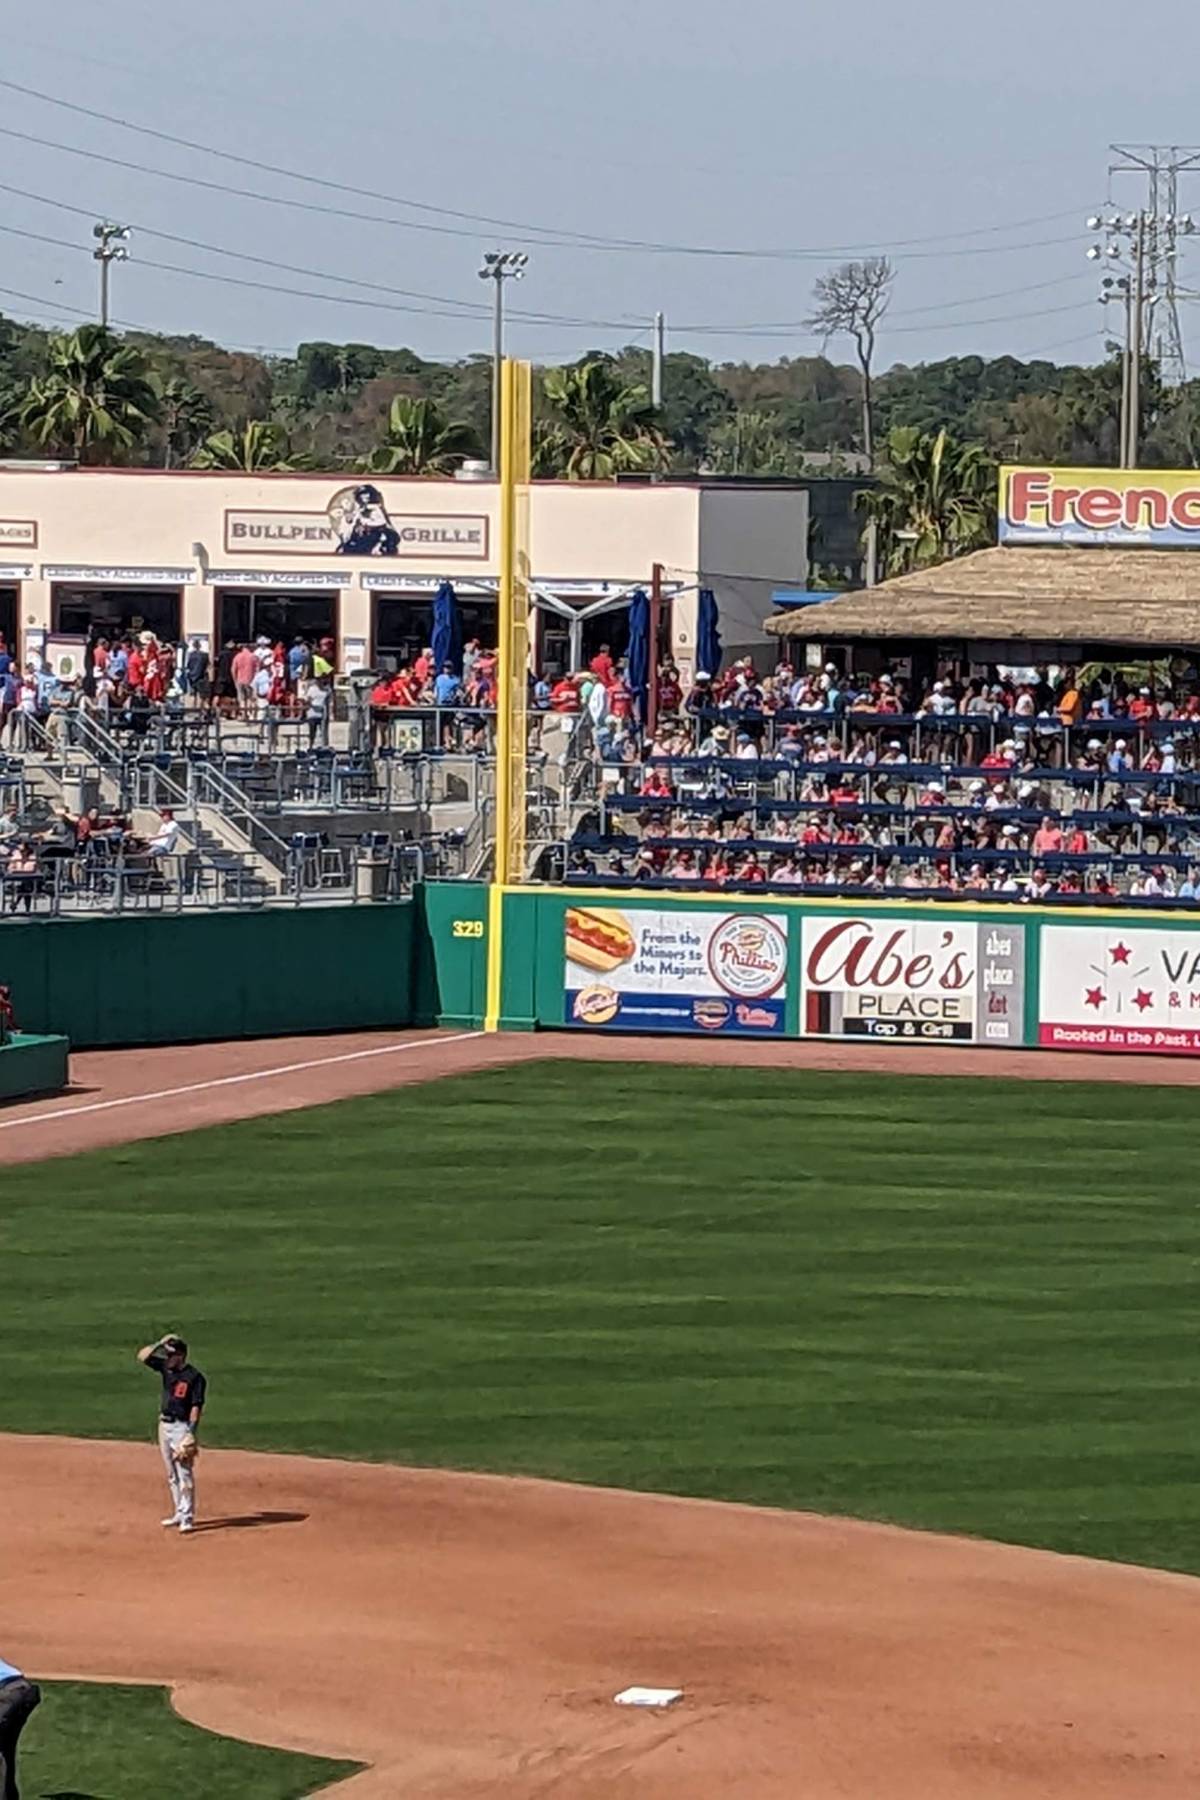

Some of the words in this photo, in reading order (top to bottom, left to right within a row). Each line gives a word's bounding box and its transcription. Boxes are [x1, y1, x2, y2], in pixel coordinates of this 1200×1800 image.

[453, 920, 483, 938] 329
[641, 929, 676, 945] From
[679, 930, 701, 946] the
[640, 946, 685, 961] Minors
[689, 948, 703, 961] to
[806, 920, 975, 990] Abe's
[633, 961, 655, 975] the
[858, 994, 961, 1018] PLACE
[1168, 990, 1182, 1009] &
[902, 1021, 916, 1036] &
[1053, 1027, 1106, 1043] Rooted
[1109, 1029, 1124, 1043] in
[1127, 1030, 1152, 1045] the
